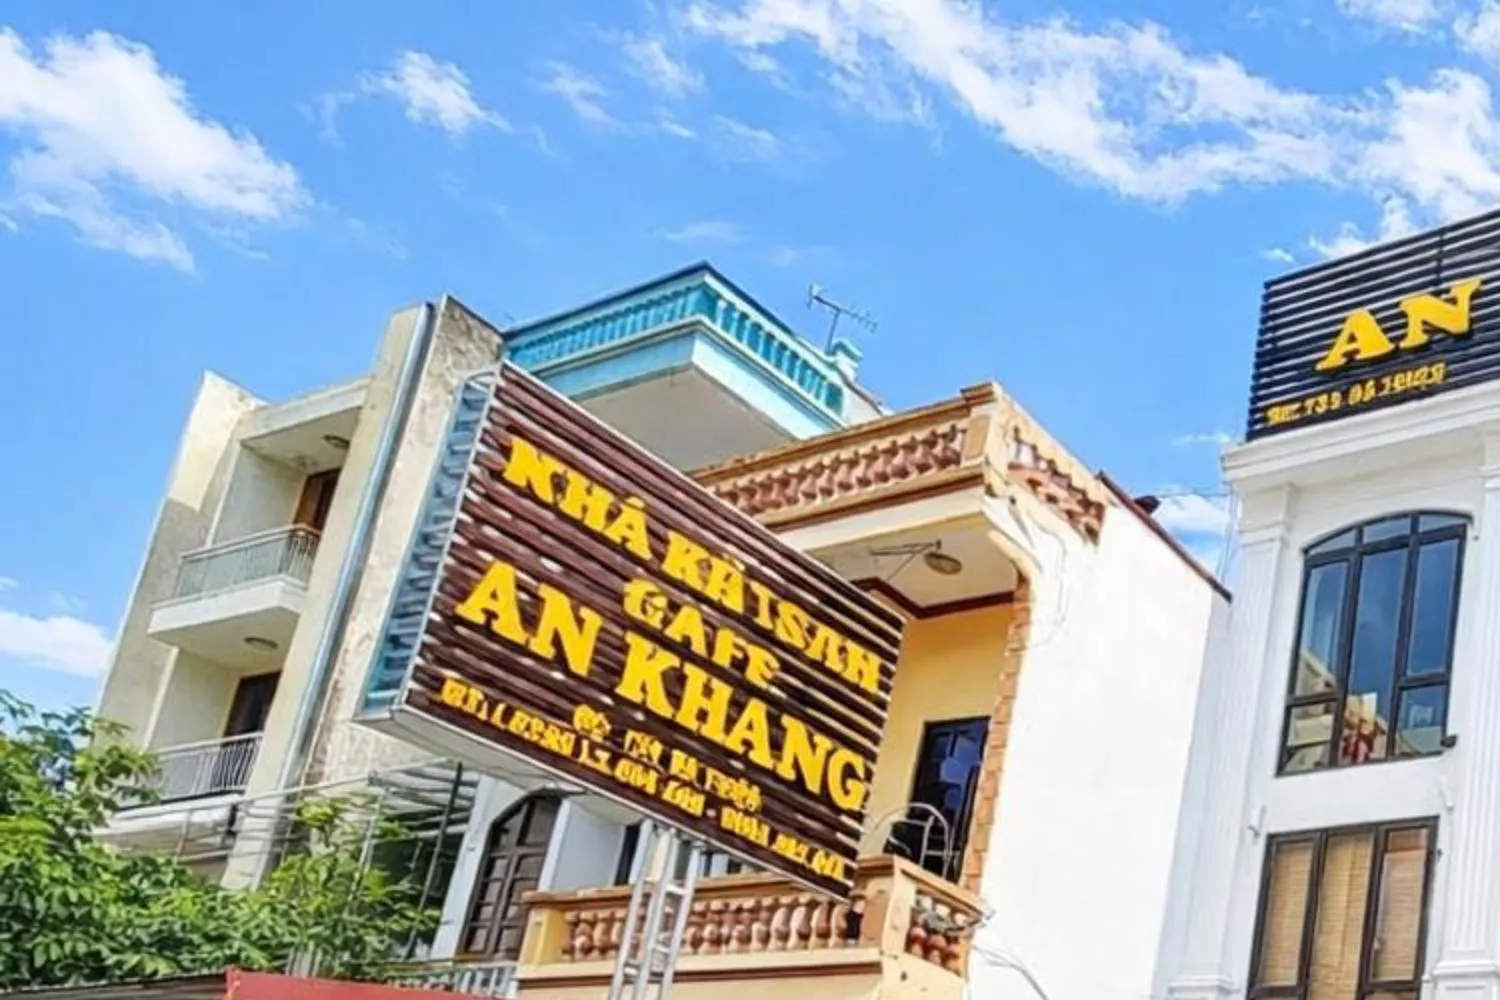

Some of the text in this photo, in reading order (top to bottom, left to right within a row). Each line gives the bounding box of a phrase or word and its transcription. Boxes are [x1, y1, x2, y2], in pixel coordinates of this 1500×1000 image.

[1316, 281, 1481, 370] AN
[455, 560, 603, 678] AN
[615, 633, 866, 812] KHANG
